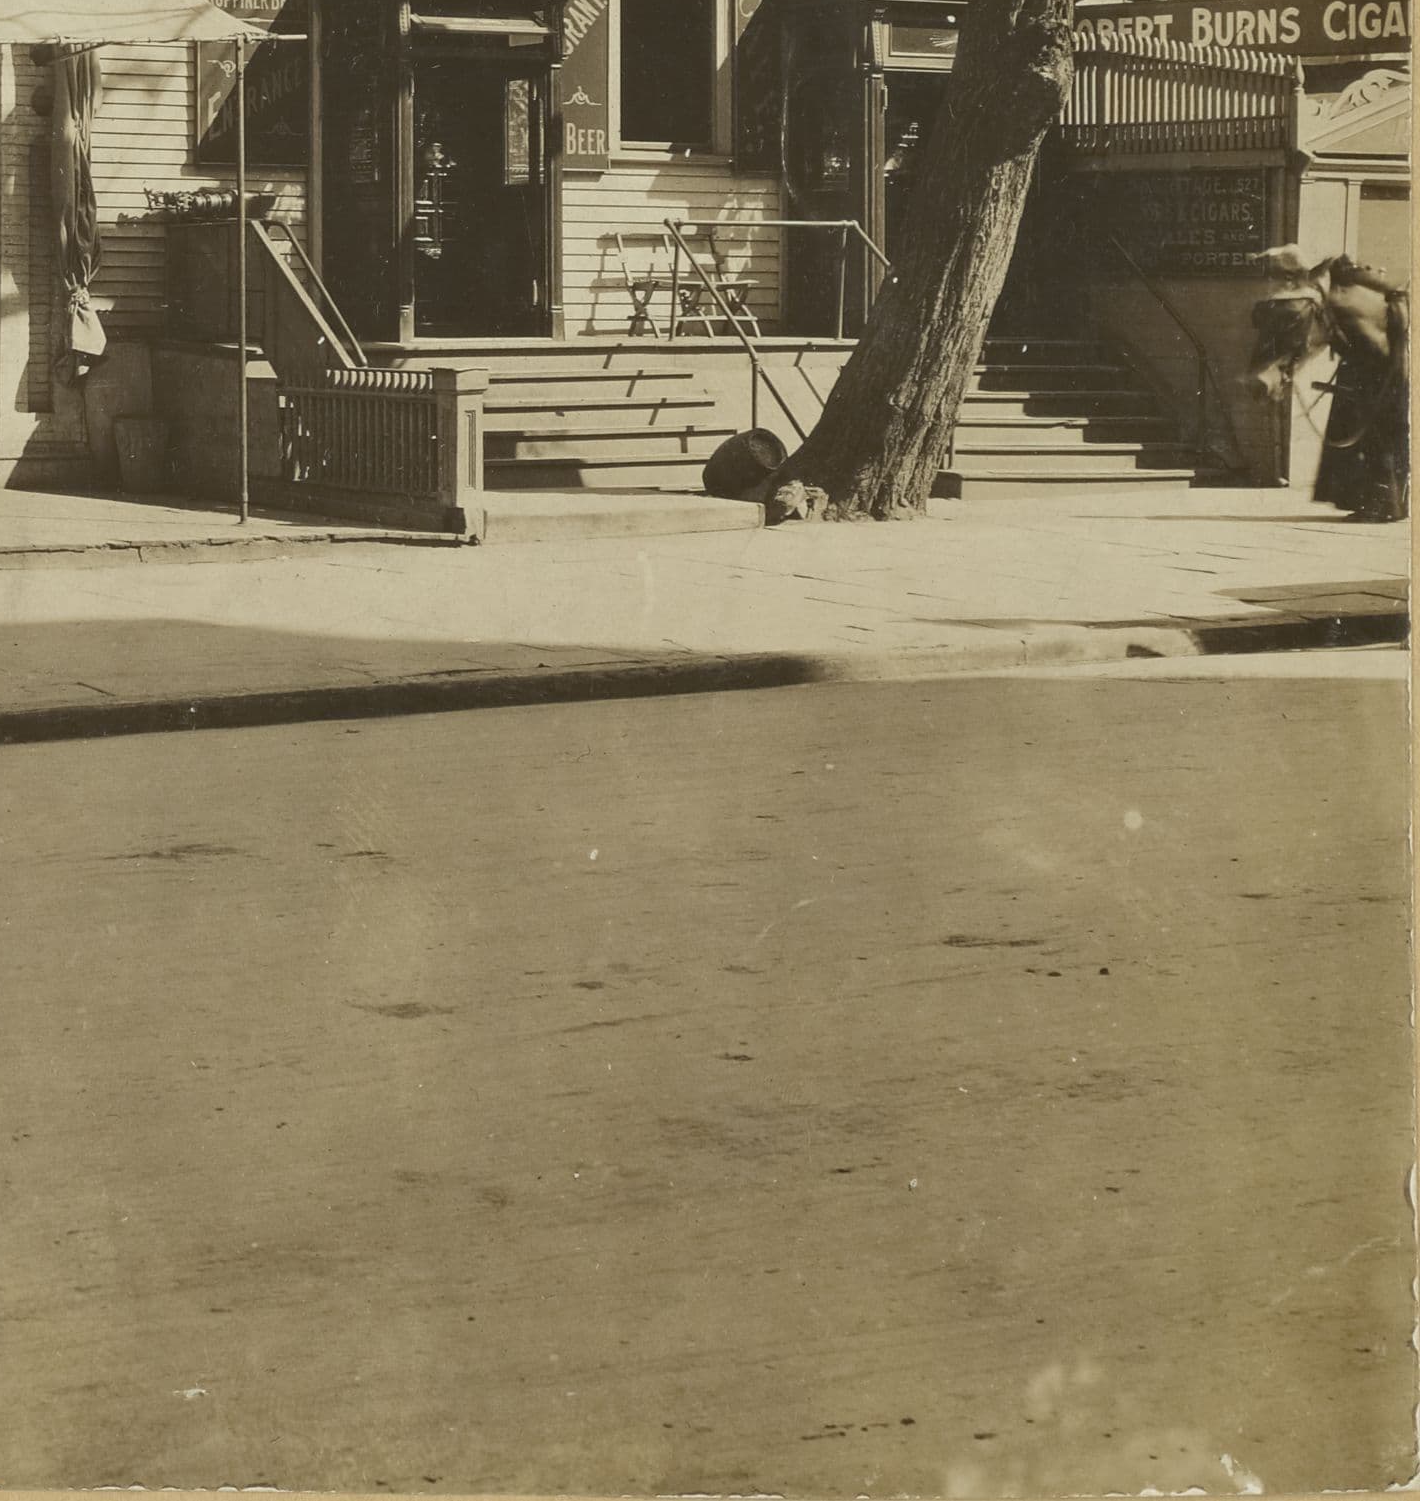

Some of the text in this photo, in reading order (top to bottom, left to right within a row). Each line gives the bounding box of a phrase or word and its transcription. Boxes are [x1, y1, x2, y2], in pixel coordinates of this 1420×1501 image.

[1076, 1, 1412, 48] OBERT BURNS CIGA
